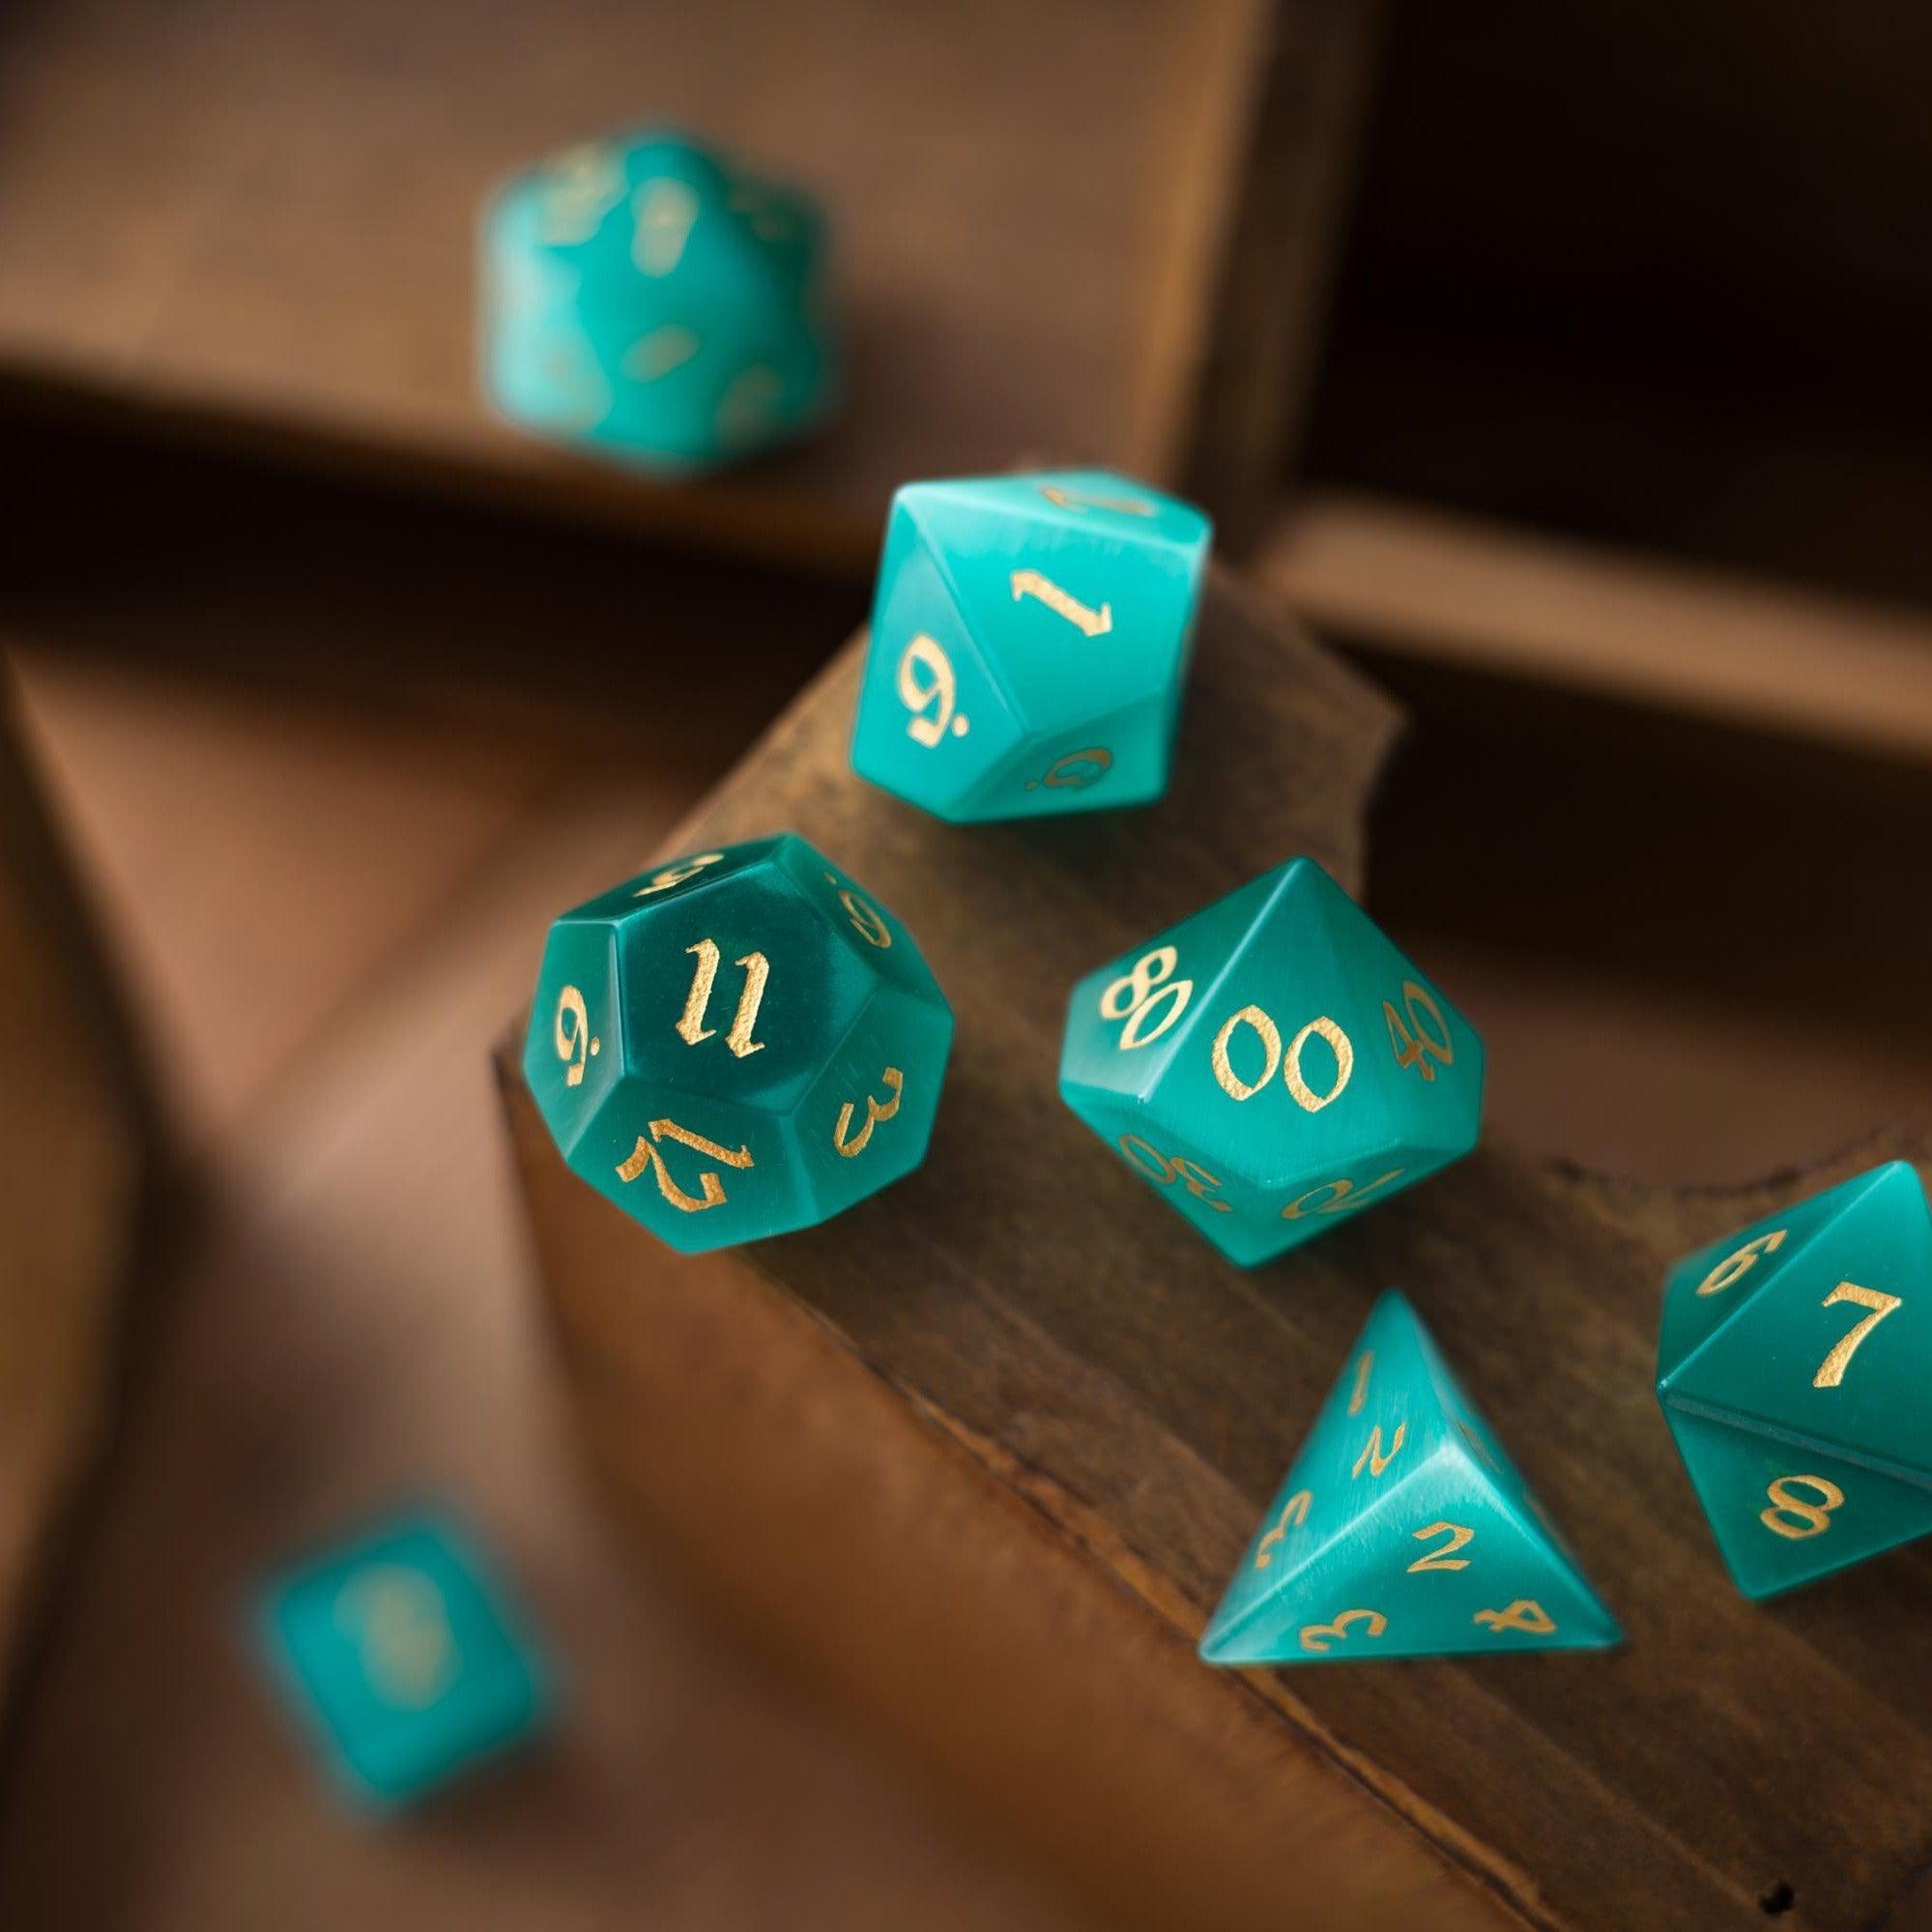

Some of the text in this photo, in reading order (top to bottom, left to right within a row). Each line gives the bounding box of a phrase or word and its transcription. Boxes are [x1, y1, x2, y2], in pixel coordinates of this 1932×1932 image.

[1009, 569, 1112, 637] 1
[676, 938, 770, 1058] 11
[1100, 945, 1194, 1051] 80
[1382, 980, 1453, 1081] 40
[1211, 1004, 1354, 1113] 00
[833, 1067, 903, 1158] 3
[615, 1118, 755, 1212] 12
[1696, 1229, 1788, 1298] 6
[1813, 1281, 1902, 1388] 7
[1406, 1521, 1475, 1573] 2
[1760, 1474, 1845, 1541] 8
[1299, 1609, 1387, 1652] 3
[1474, 1599, 1557, 1633] 4
